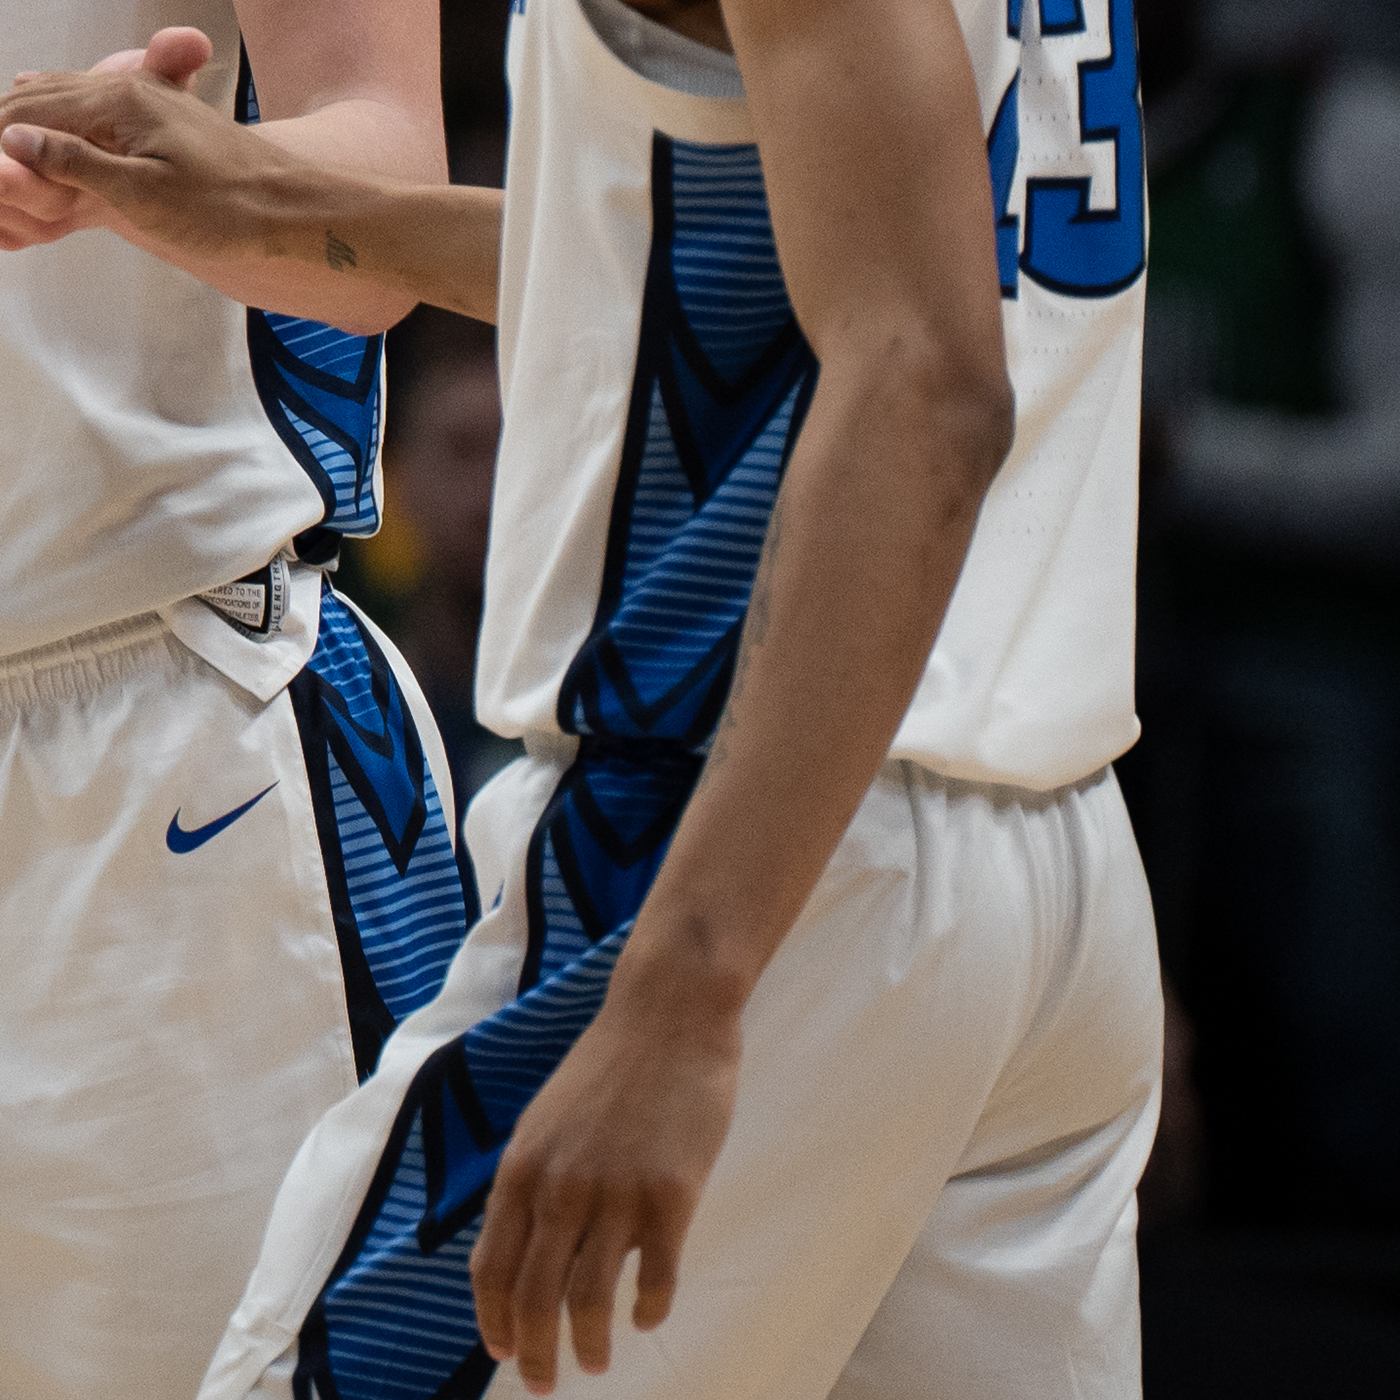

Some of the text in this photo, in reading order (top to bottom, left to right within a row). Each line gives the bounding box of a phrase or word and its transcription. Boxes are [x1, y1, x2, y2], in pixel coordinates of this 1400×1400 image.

[235, 587, 245, 597] TO
[247, 588, 261, 598] THE
[252, 601, 261, 609] OF
